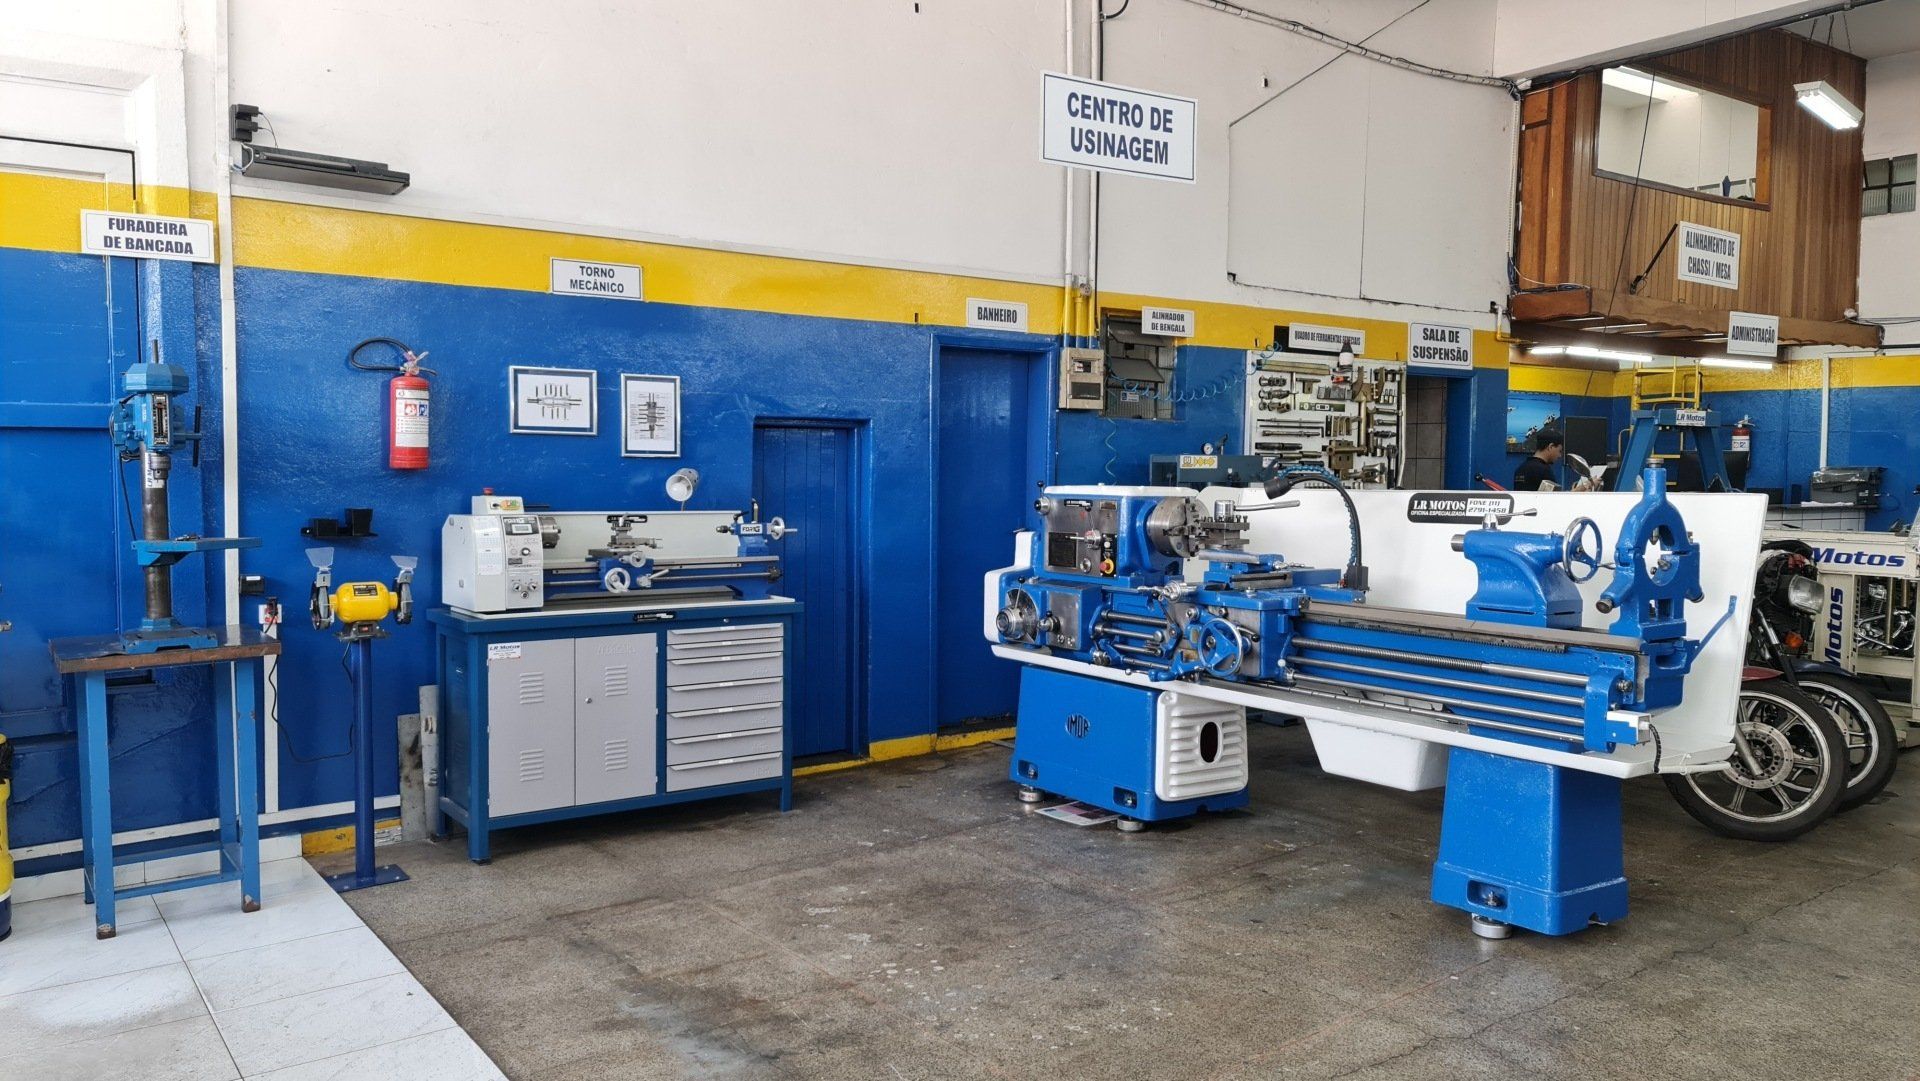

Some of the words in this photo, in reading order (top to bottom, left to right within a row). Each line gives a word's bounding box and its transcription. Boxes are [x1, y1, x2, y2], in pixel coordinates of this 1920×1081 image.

[1067, 92, 1143, 128] CENTRO
[1150, 107, 1173, 133] DE
[1070, 126, 1168, 165] USINAGEM
[108, 217, 188, 237] FURADEIRA
[103, 235, 122, 249] DE
[125, 237, 194, 255] BANCADA
[1685, 230, 1727, 256] ALINHAMENTO
[1728, 239, 1735, 257] DE
[579, 265, 615, 279] TORNO
[1687, 256, 1711, 276] CHASSI
[1711, 260, 1716, 277] /
[1716, 261, 1731, 280] MESA
[570, 279, 625, 293] MECÂNICO
[977, 306, 1017, 324] BANHEIRO
[1152, 311, 1185, 322] ALINHADOR
[1151, 322, 1159, 331] DE
[1160, 323, 1186, 333] BENGALA
[1294, 330, 1310, 341] QUADRO
[1311, 331, 1316, 342] DE
[1422, 327, 1446, 342] SALA
[1448, 330, 1460, 343] DE
[1731, 325, 1775, 346] ADMINISTRAÇÃO
[1412, 345, 1469, 362] SUSPENSÃO
[1676, 413, 1685, 421] LR
[1686, 413, 1705, 422] Motos
[1413, 500, 1427, 510] LR
[1428, 500, 1466, 511] MOTOS
[1812, 547, 1906, 568] Motos
[1825, 587, 1843, 666] Motos
